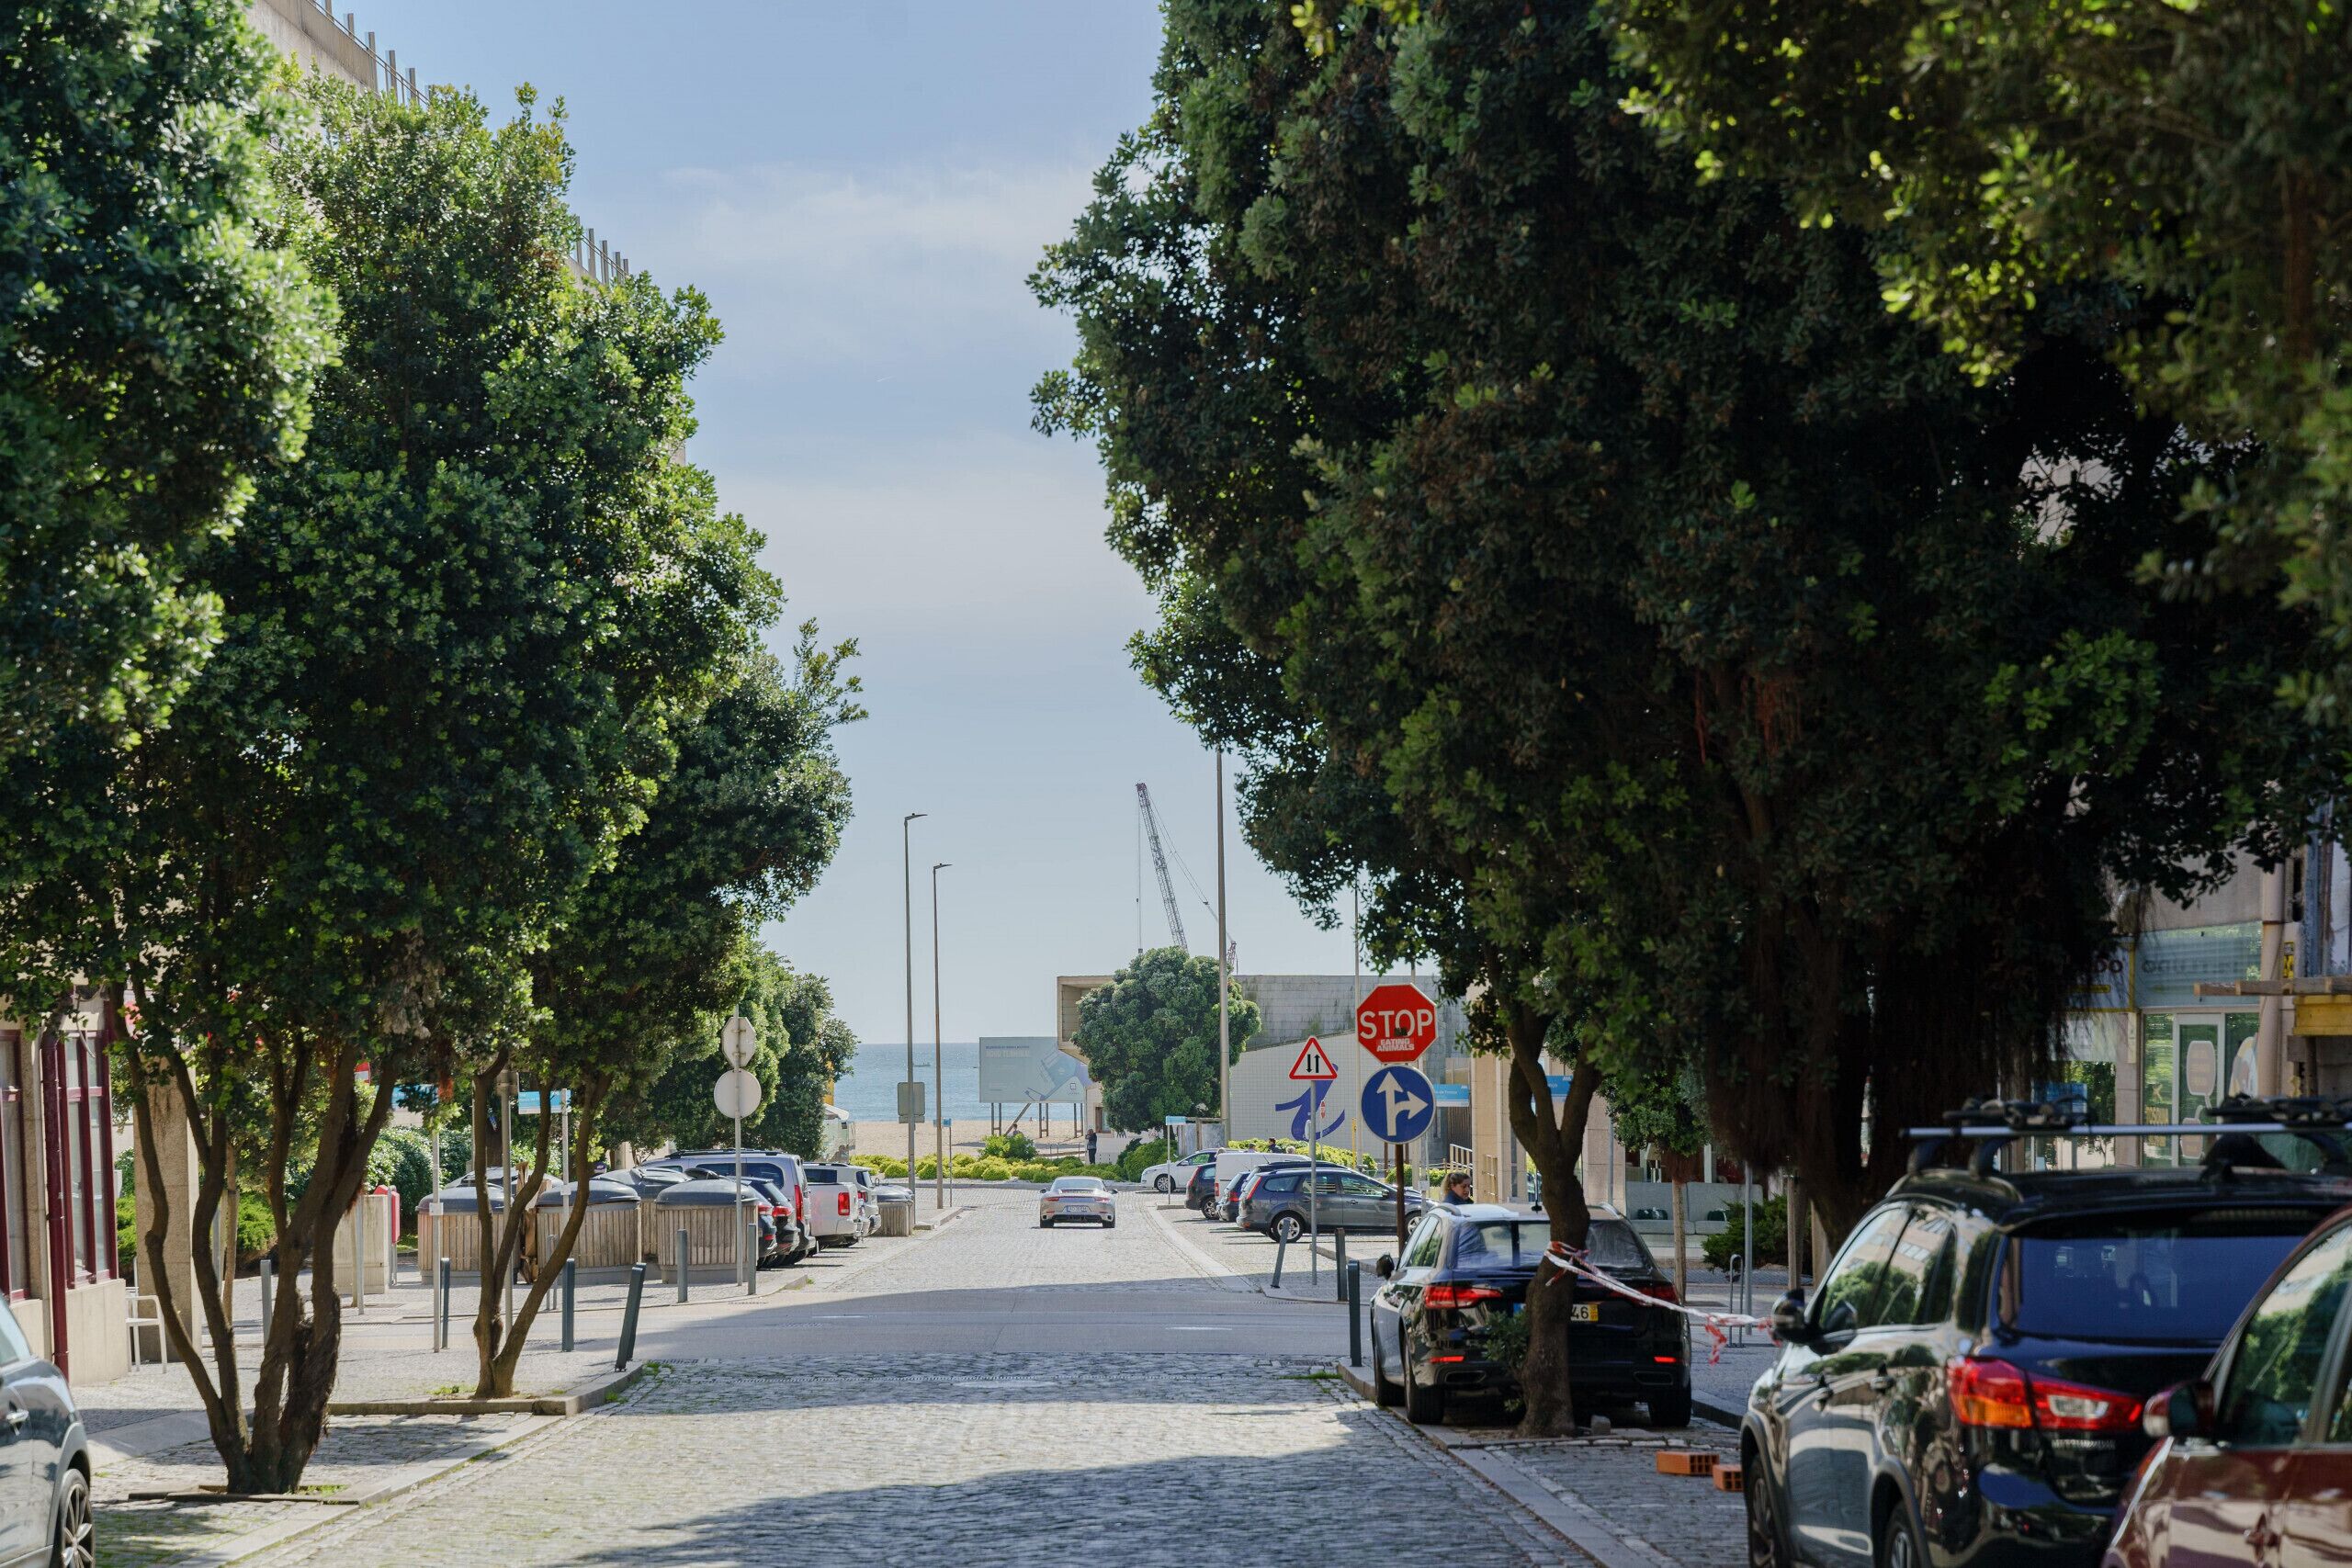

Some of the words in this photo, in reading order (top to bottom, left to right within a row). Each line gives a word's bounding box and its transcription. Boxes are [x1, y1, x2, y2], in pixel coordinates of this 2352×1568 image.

[1360, 1009, 1433, 1039] STOP
[1376, 1043, 1415, 1052] ANIMALS
[1572, 1306, 1589, 1320] 46
